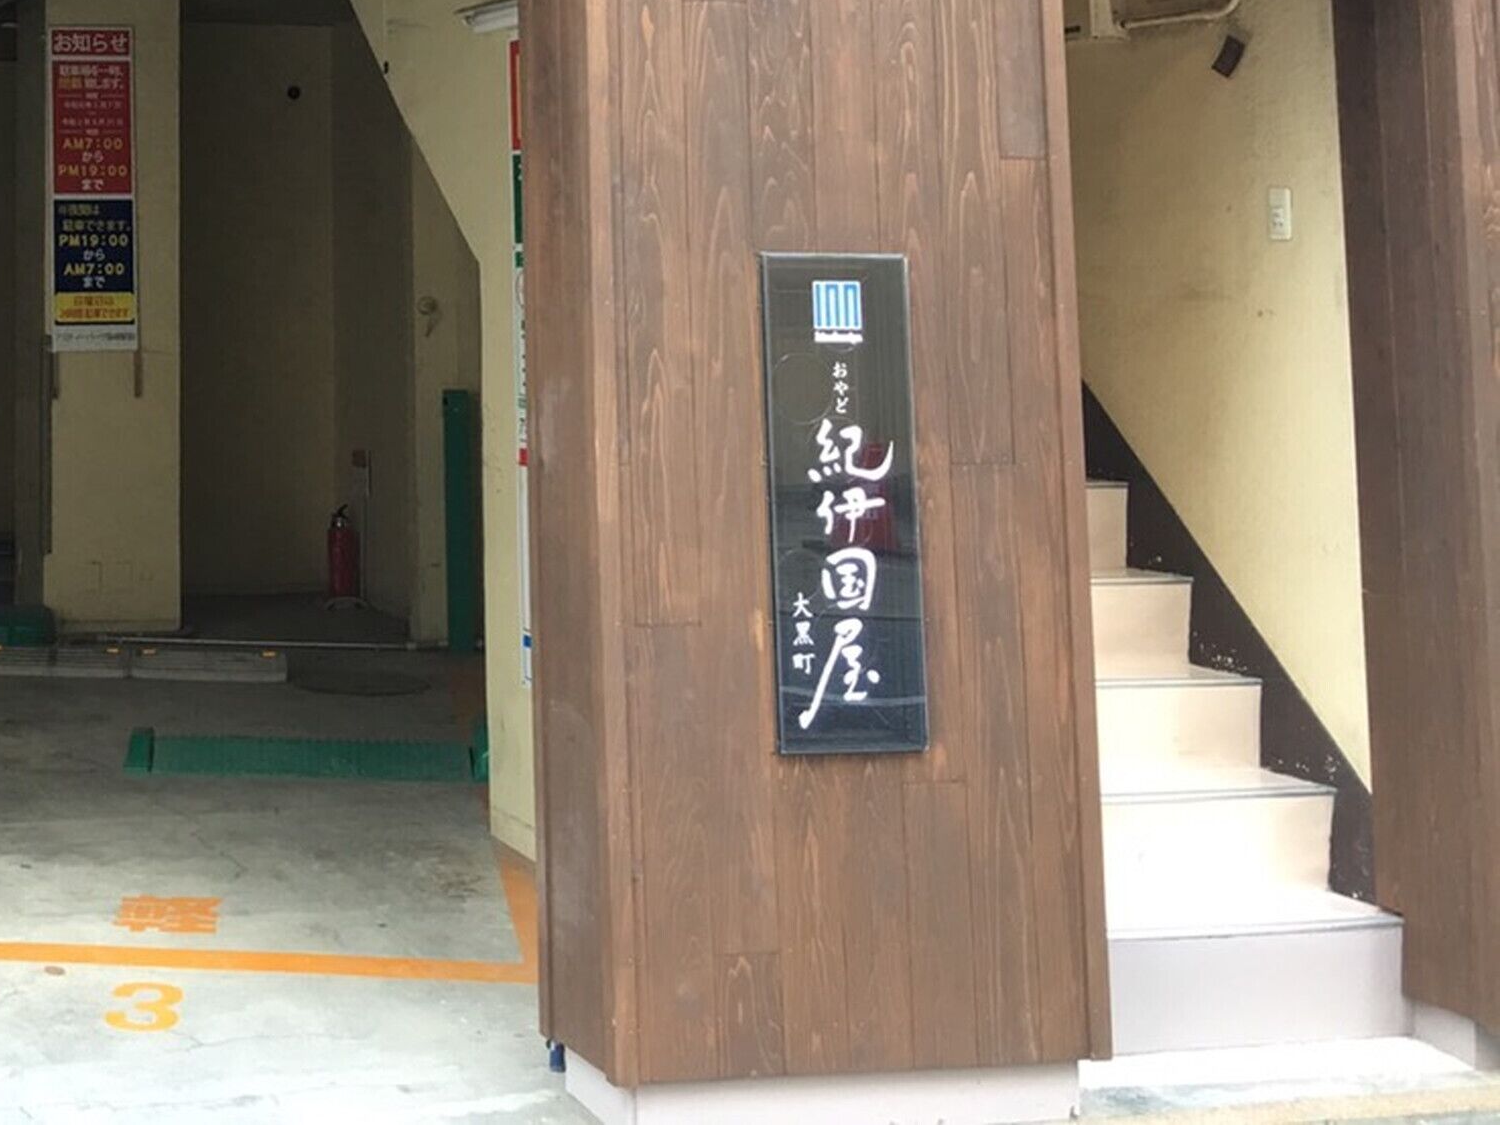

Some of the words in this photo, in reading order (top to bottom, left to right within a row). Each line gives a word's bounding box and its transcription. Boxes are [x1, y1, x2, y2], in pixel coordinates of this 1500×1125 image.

[54, 33, 128, 52] お知らせ
[831, 361, 849, 414] おやど
[798, 417, 894, 729] 紀伊国屋
[792, 592, 815, 675] 大黒町
[104, 981, 185, 1033] 3
